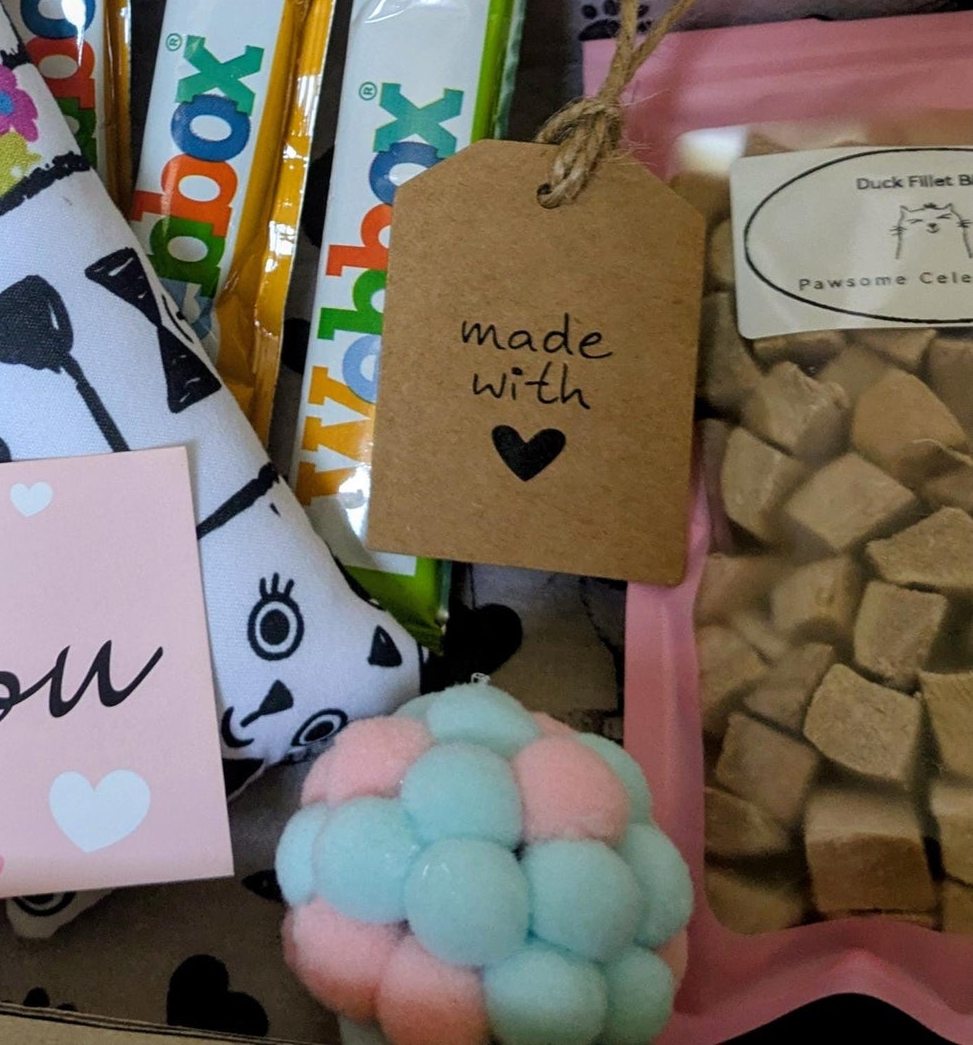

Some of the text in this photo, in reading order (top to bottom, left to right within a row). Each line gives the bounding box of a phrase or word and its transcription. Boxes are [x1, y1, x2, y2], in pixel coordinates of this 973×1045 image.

[856, 177, 903, 190] Duck
[909, 175, 954, 187] Fillet
[799, 272, 973, 291] Pawsome Cele
[461, 314, 613, 359] made
[472, 361, 590, 410] with
